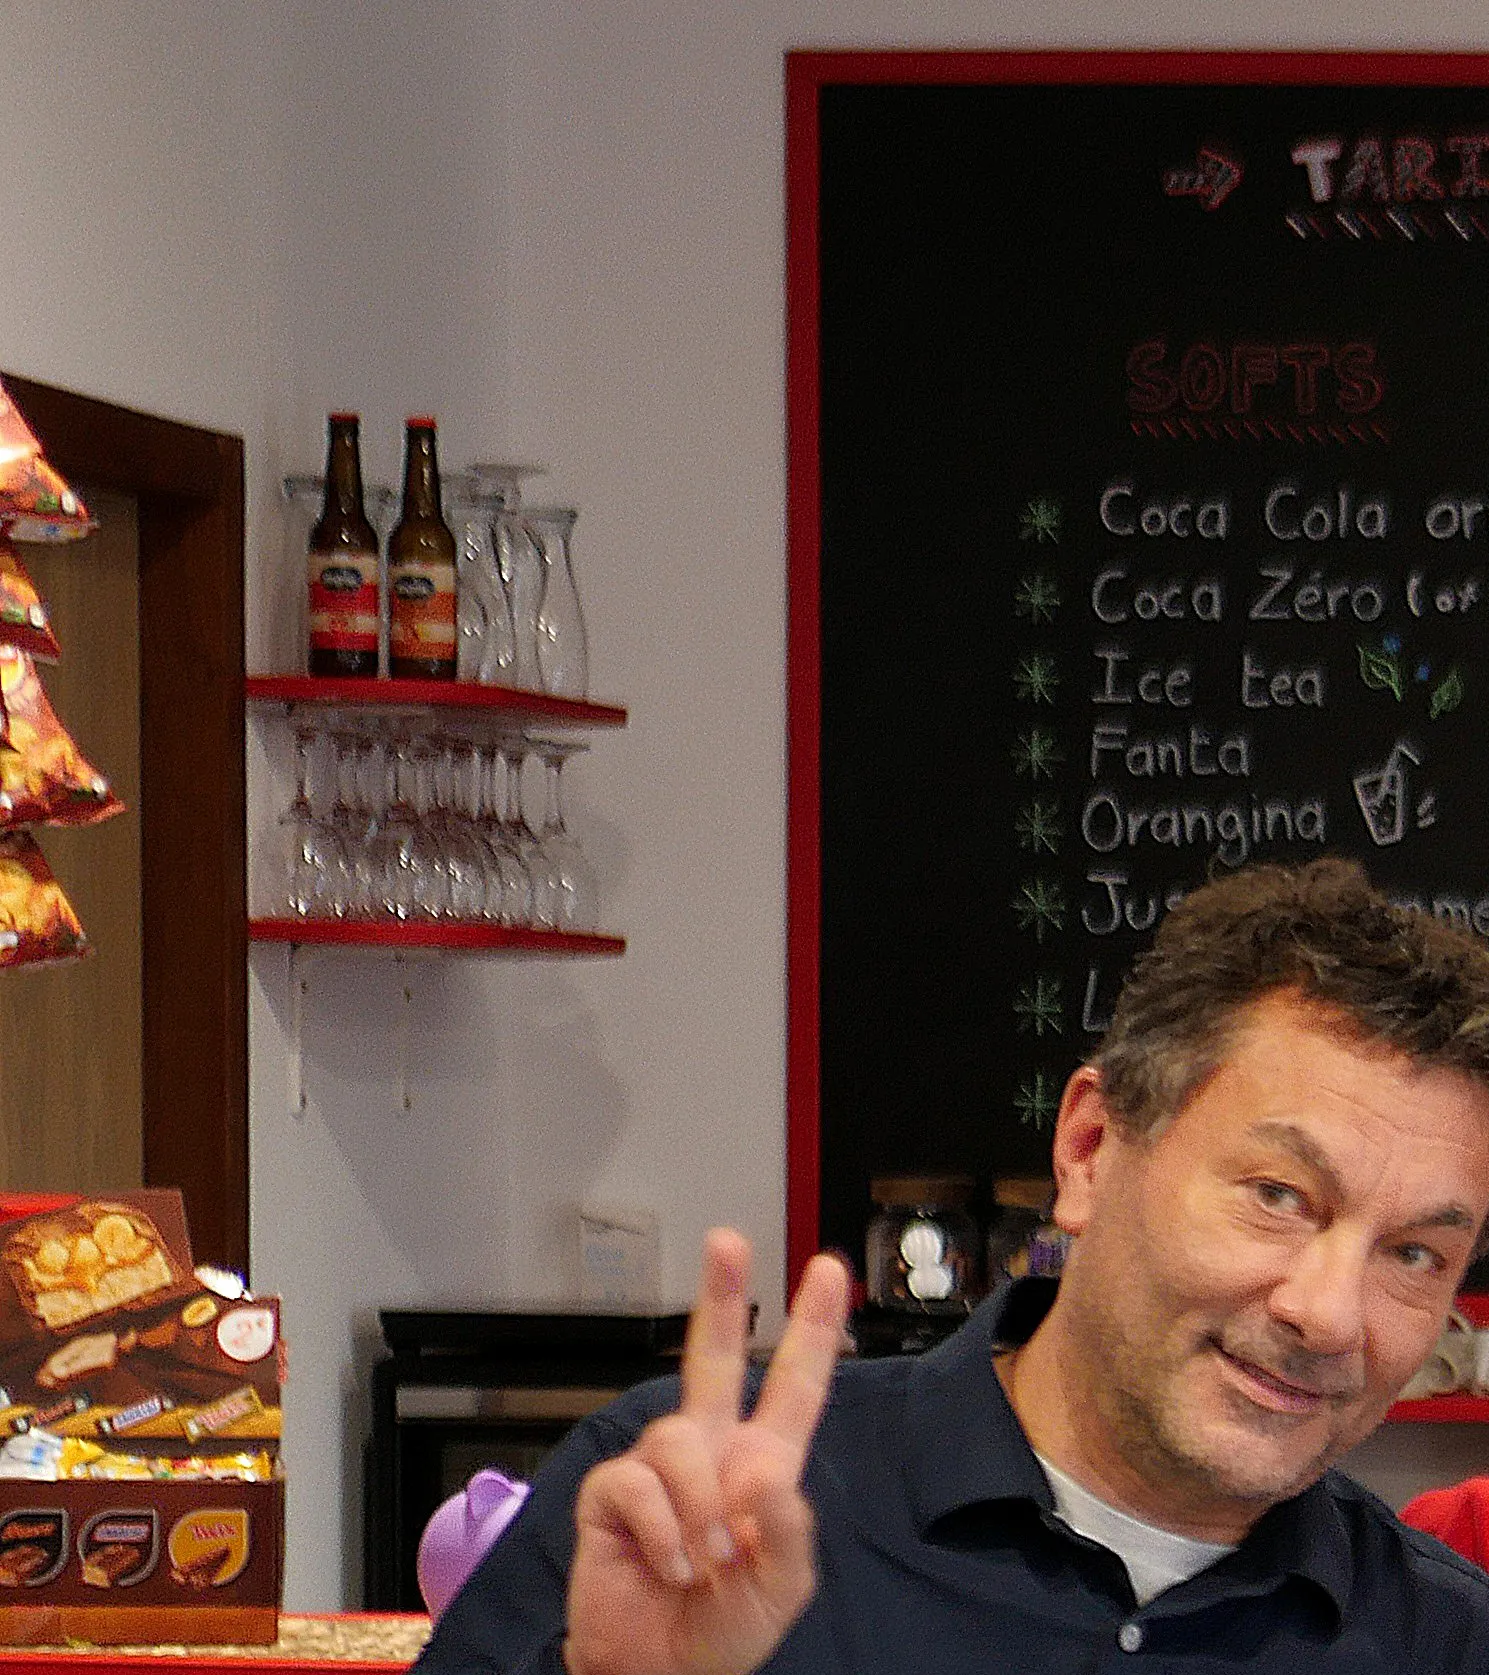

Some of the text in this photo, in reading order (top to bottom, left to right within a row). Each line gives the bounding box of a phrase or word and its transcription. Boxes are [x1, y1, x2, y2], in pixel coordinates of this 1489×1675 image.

[1126, 340, 1384, 415] SOFTS
[1099, 484, 1230, 540] Coca
[1263, 482, 1388, 541] Cola
[1091, 568, 1221, 624] Coca
[1249, 566, 1384, 622] Zéro
[1093, 646, 1323, 708] Ice tea
[1089, 724, 1250, 778] Fanta
[1080, 792, 1326, 868] Orangina
